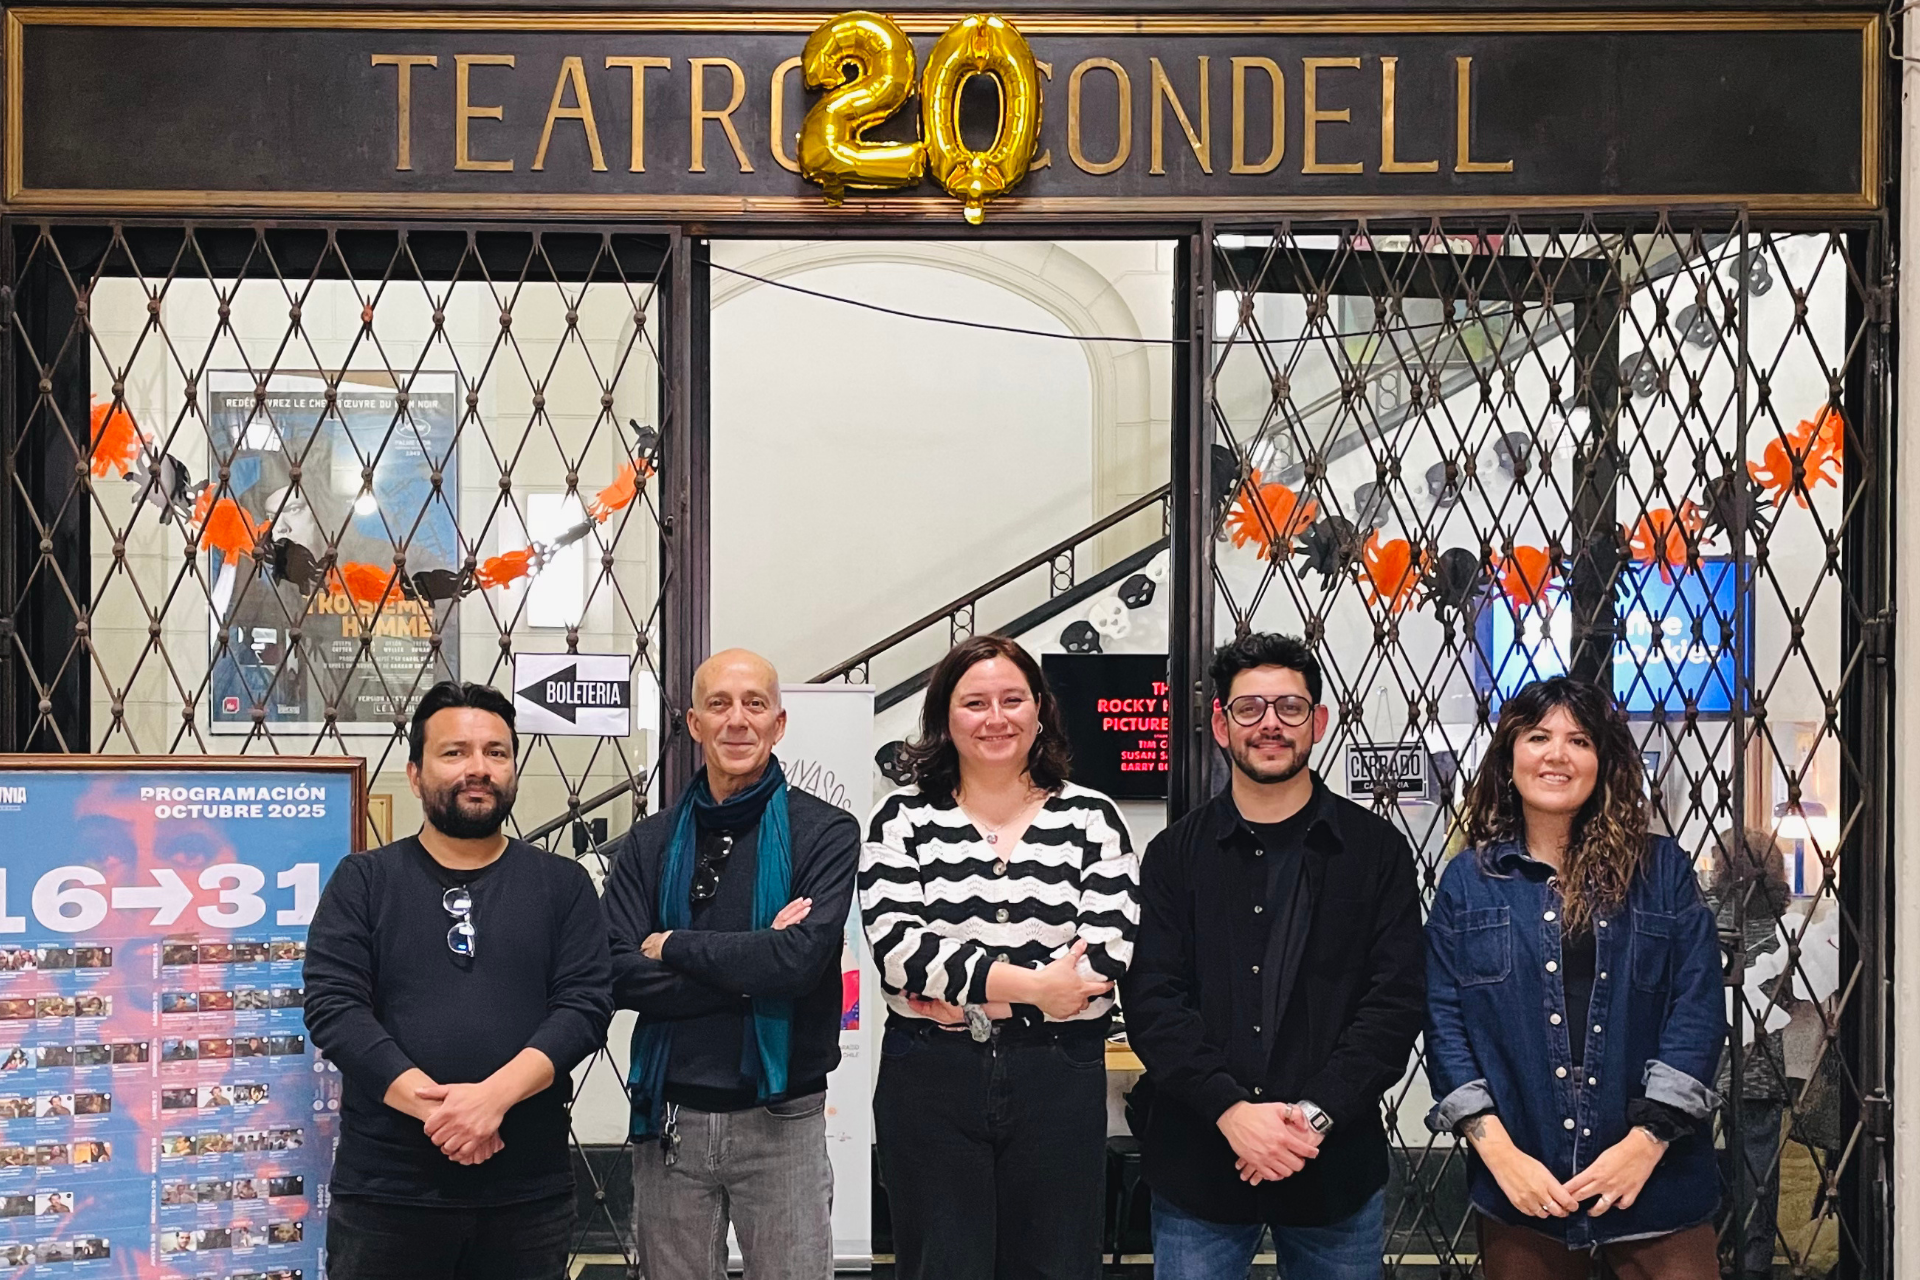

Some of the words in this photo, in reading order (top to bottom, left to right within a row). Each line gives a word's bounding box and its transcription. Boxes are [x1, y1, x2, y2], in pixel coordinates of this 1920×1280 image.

[798, 10, 1043, 212] 20
[1030, 54, 1514, 175] ONDELL
[226, 397, 291, 408] REDÉCVREZ
[293, 399, 306, 408] LE
[308, 399, 328, 408] CHE
[379, 399, 392, 409] DU
[418, 400, 439, 409] NOIR
[342, 615, 433, 637] HMME
[546, 681, 621, 705] BOLETERIA
[1152, 682, 1169, 696] TH
[1097, 699, 1156, 713] ROCKY
[1102, 717, 1169, 731] PICTURE
[1138, 740, 1156, 749] TIM
[1121, 750, 1156, 760] SUSAN
[1121, 762, 1154, 771] BARRY
[1351, 754, 1420, 778] CERRADO
[140, 783, 326, 802] PROGRAMACIÓN
[154, 804, 263, 819] OCTUBRE
[268, 804, 326, 819] 2025
[197, 862, 321, 929] 31
